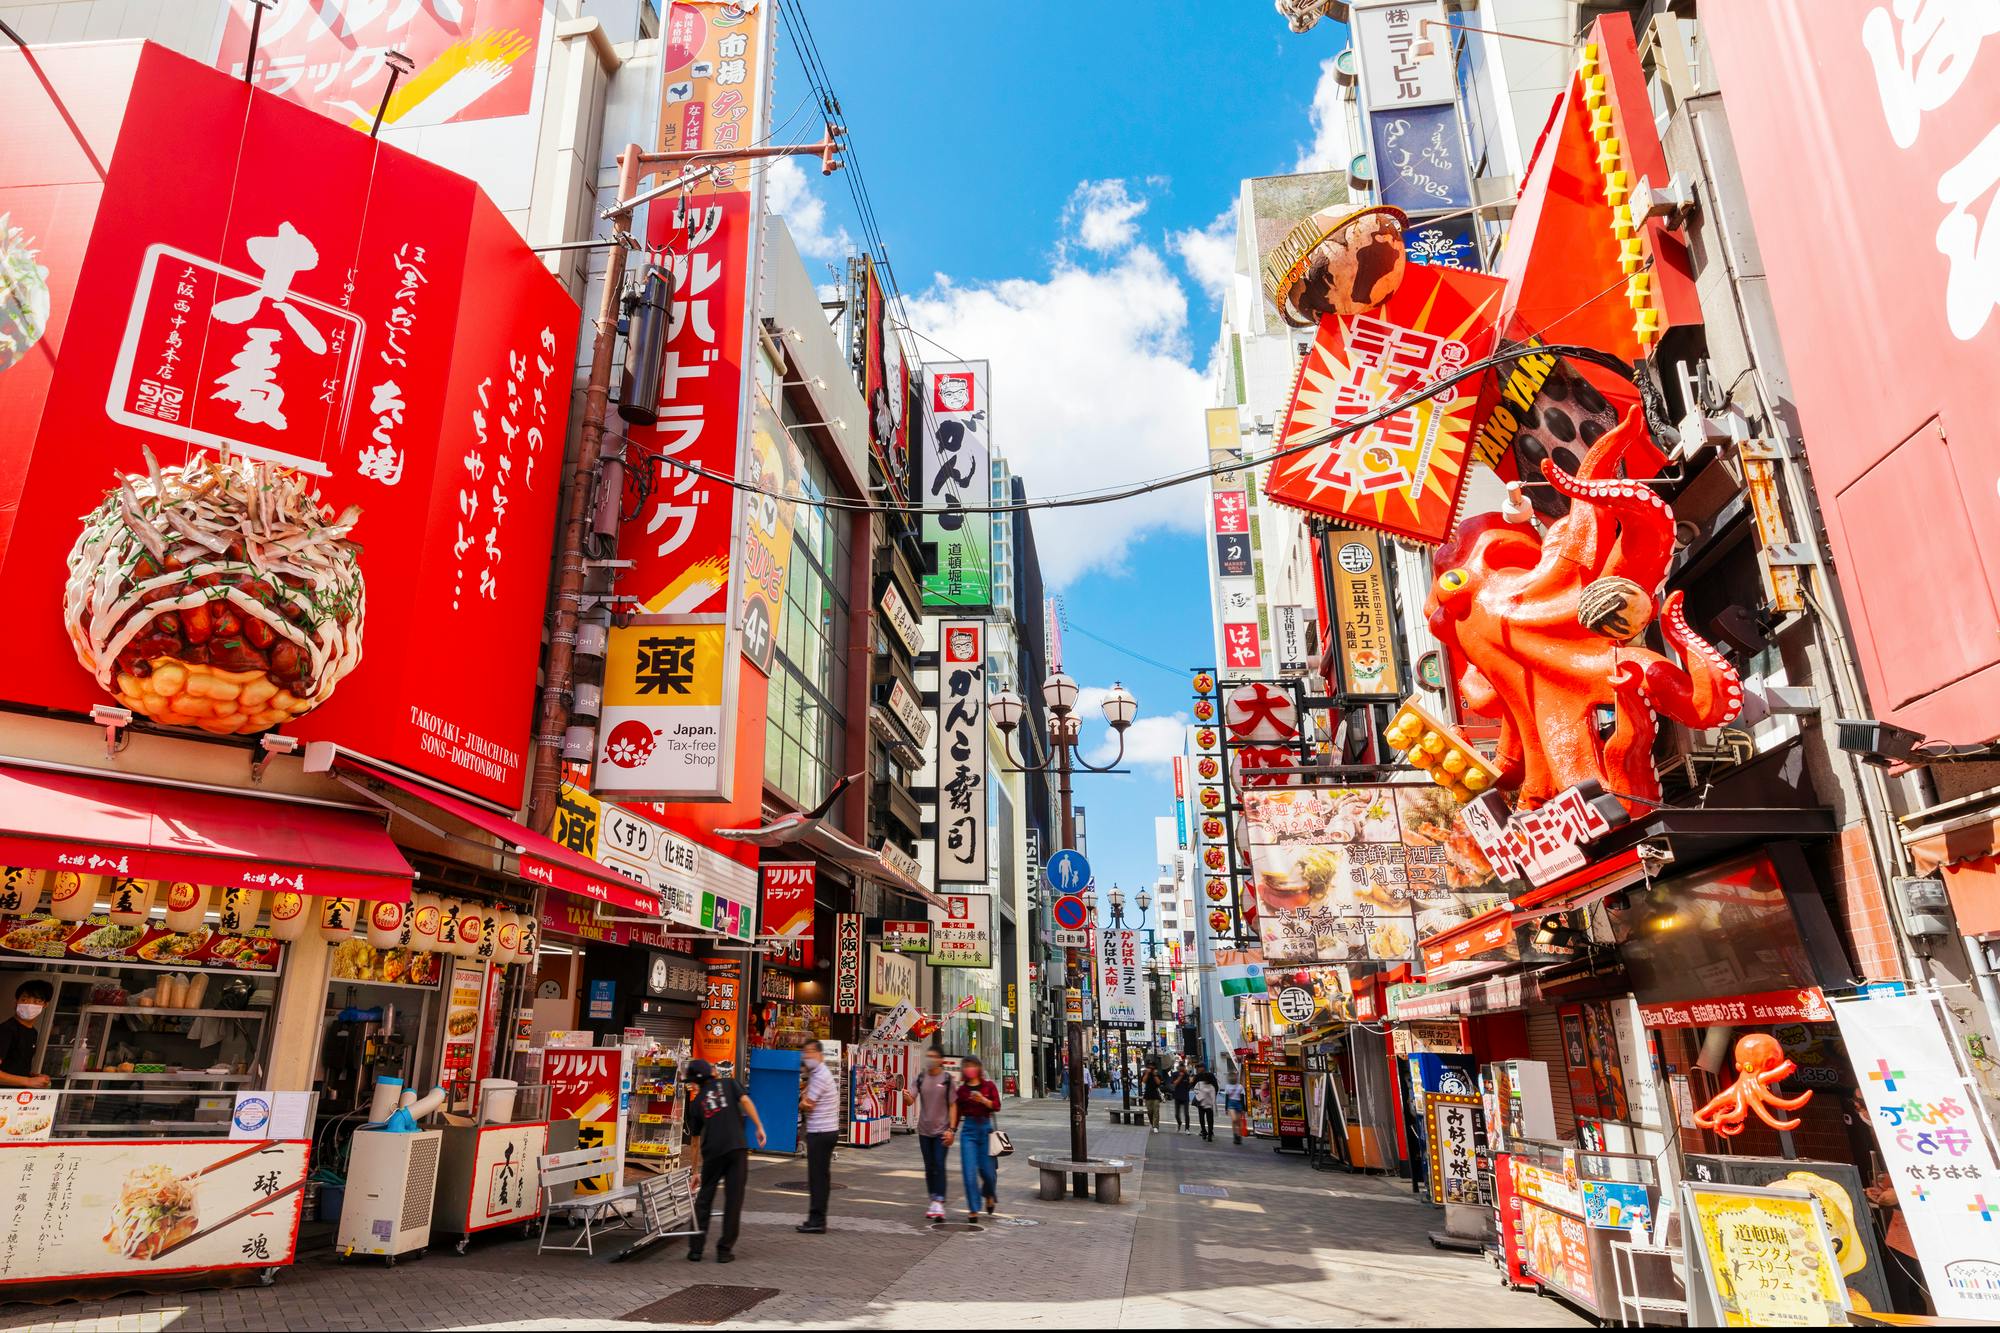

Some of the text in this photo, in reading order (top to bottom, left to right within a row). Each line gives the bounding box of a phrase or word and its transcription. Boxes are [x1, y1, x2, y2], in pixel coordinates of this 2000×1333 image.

[711, 32, 750, 188] 市場タッカビ
[1393, 148, 1453, 205] James
[156, 266, 197, 380] 大阪西中島本店
[331, 328, 346, 354] はち
[319, 378, 340, 405] ばん
[646, 206, 724, 558] ツルハドラッグ
[1472, 337, 1557, 471] TAKO YAKI
[931, 408, 986, 531] がんこ
[947, 542, 963, 597] 道頓堀店
[1351, 580, 1374, 649] 豆柴カフェ
[1370, 573, 1389, 664] MAMESHIBA CAFE
[744, 607, 769, 657] 4F
[1228, 624, 1256, 667] はや
[1344, 621, 1358, 649] 大阪店
[635, 636, 695, 695] 薬
[410, 705, 520, 769] TAKOYAKI-JUHACHIBAN
[673, 723, 717, 738] Japan.
[667, 738, 717, 751] Tax-free
[421, 732, 508, 785] SONS-DOHTONBORI
[684, 752, 716, 767] Shop
[557, 798, 597, 857] 薬
[612, 817, 648, 852] くすり
[664, 839, 694, 872] 化粧品
[767, 869, 813, 885] ツルハ
[1026, 835, 1039, 911] TSUTAYA
[1350, 867, 1448, 886] 해선호프집
[766, 887, 804, 900] ドラッグ
[567, 906, 592, 926] TAX
[1274, 903, 1375, 923] 大阪名产物
[578, 925, 605, 941] STORE
[641, 931, 676, 950] WELCOME
[1056, 934, 1085, 944] 自動車
[1282, 921, 1377, 939] 오오사까특산품
[839, 919, 858, 1008] 大阪紀念品
[937, 950, 983, 962] 寿司・和食
[1120, 930, 1136, 995] がんばれミナミ
[706, 982, 735, 998] 大阪
[1691, 1001, 1749, 1023] 自由席あります
[1752, 1004, 1766, 1018] Eat
[1767, 1003, 1774, 1017] in
[1775, 1003, 1800, 1019] space.
[548, 1054, 608, 1077] ツルハ
[1439, 1071, 1466, 1081] COFFEE
[547, 1079, 594, 1096] ドラッグ
[1447, 1107, 1473, 1180] お好み焼
[1, 1154, 38, 1276] 一球に一魂のたこ焼きです
[241, 1149, 285, 1260] 一球一魂
[1732, 1223, 1790, 1245] 道頓堀
[1741, 1246, 1793, 1262] エンタメ
[1747, 1260, 1796, 1275] ストリート
[1759, 1276, 1794, 1290] カフェ
